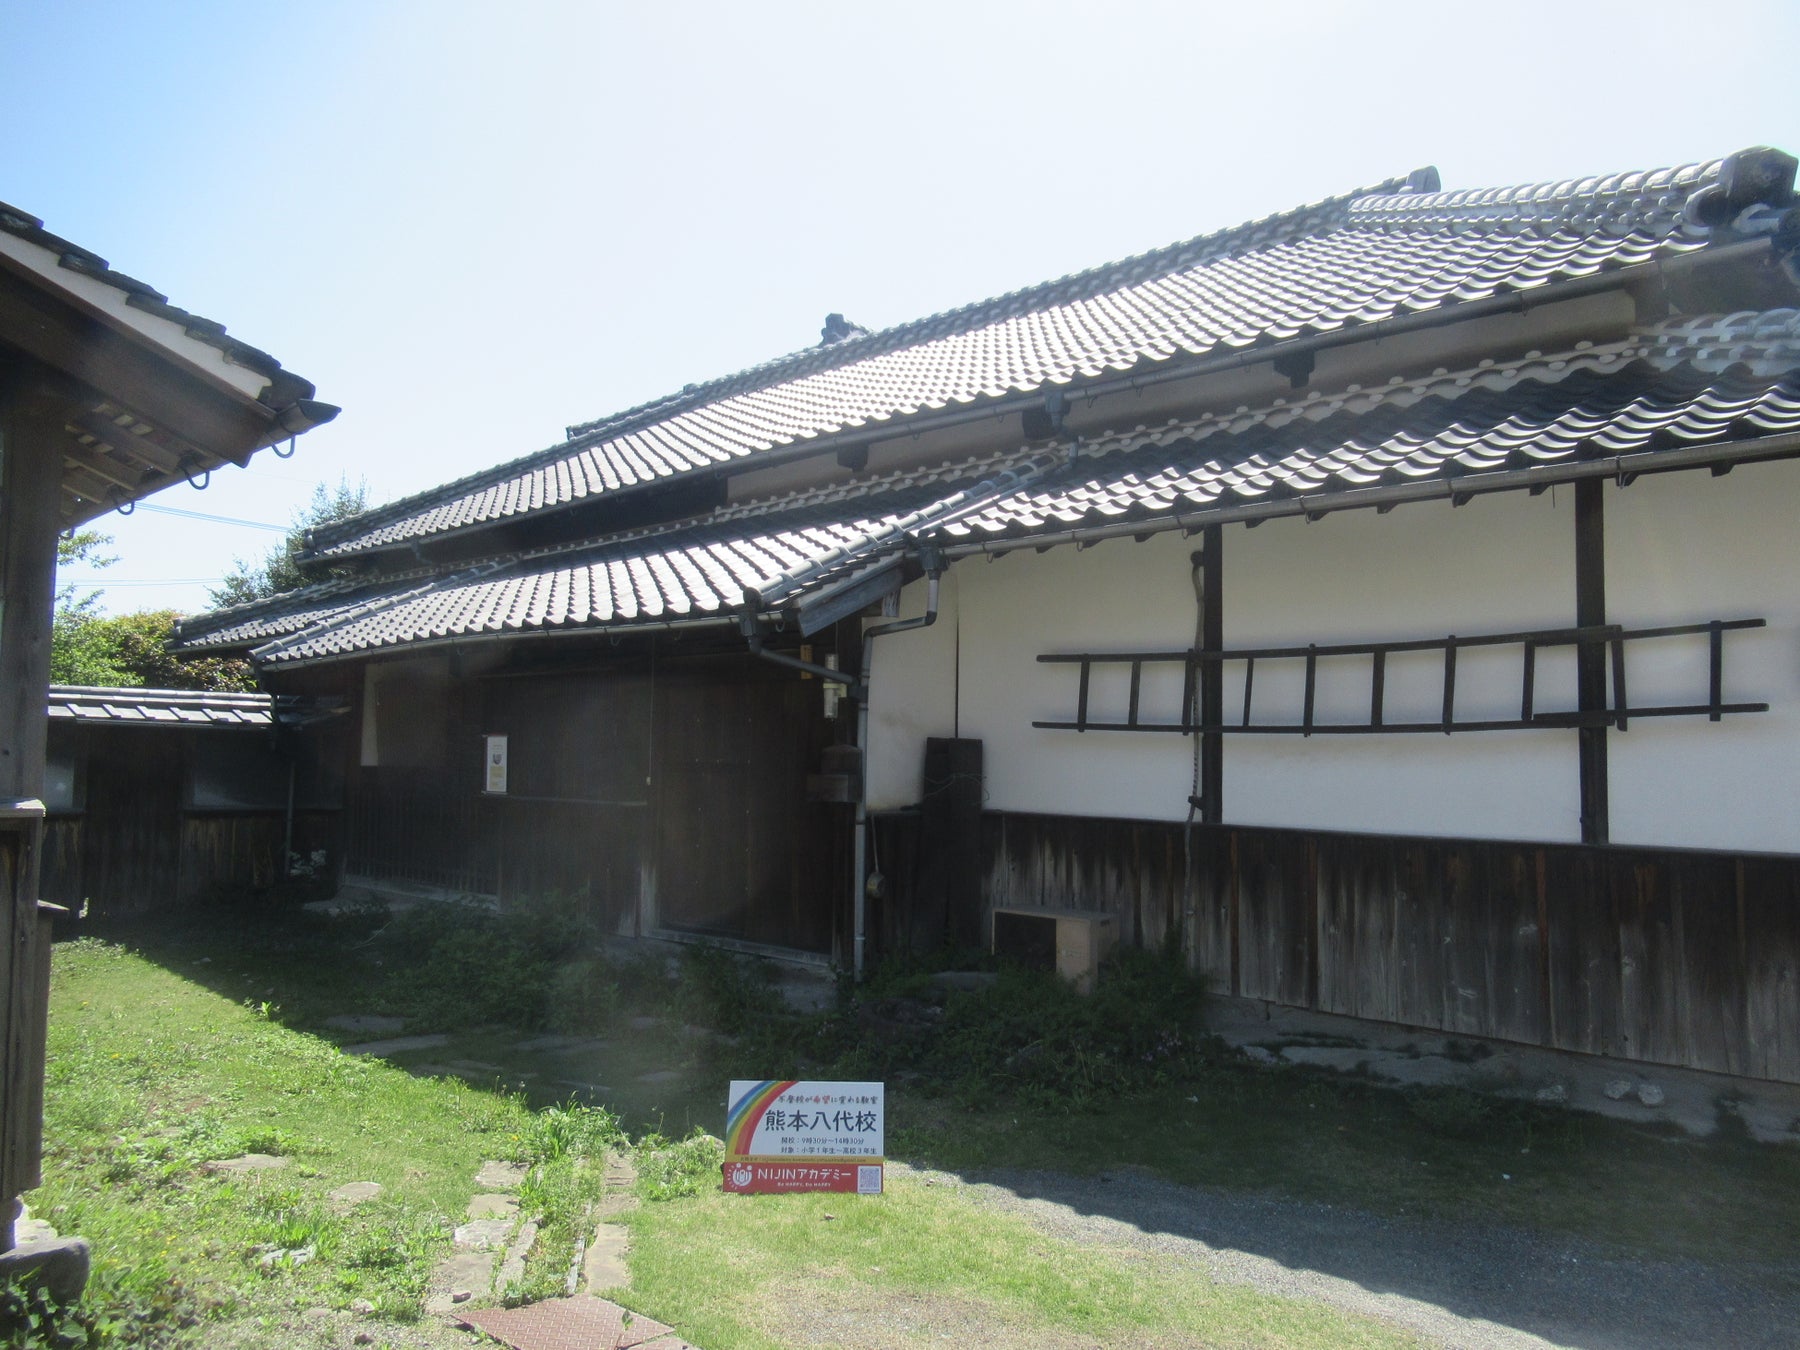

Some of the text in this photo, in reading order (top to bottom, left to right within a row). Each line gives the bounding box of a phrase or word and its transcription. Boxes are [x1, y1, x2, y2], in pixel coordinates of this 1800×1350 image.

[765, 1109, 877, 1132] 熊本八代校
[757, 1168, 852, 1181] NIJINアカデミー
